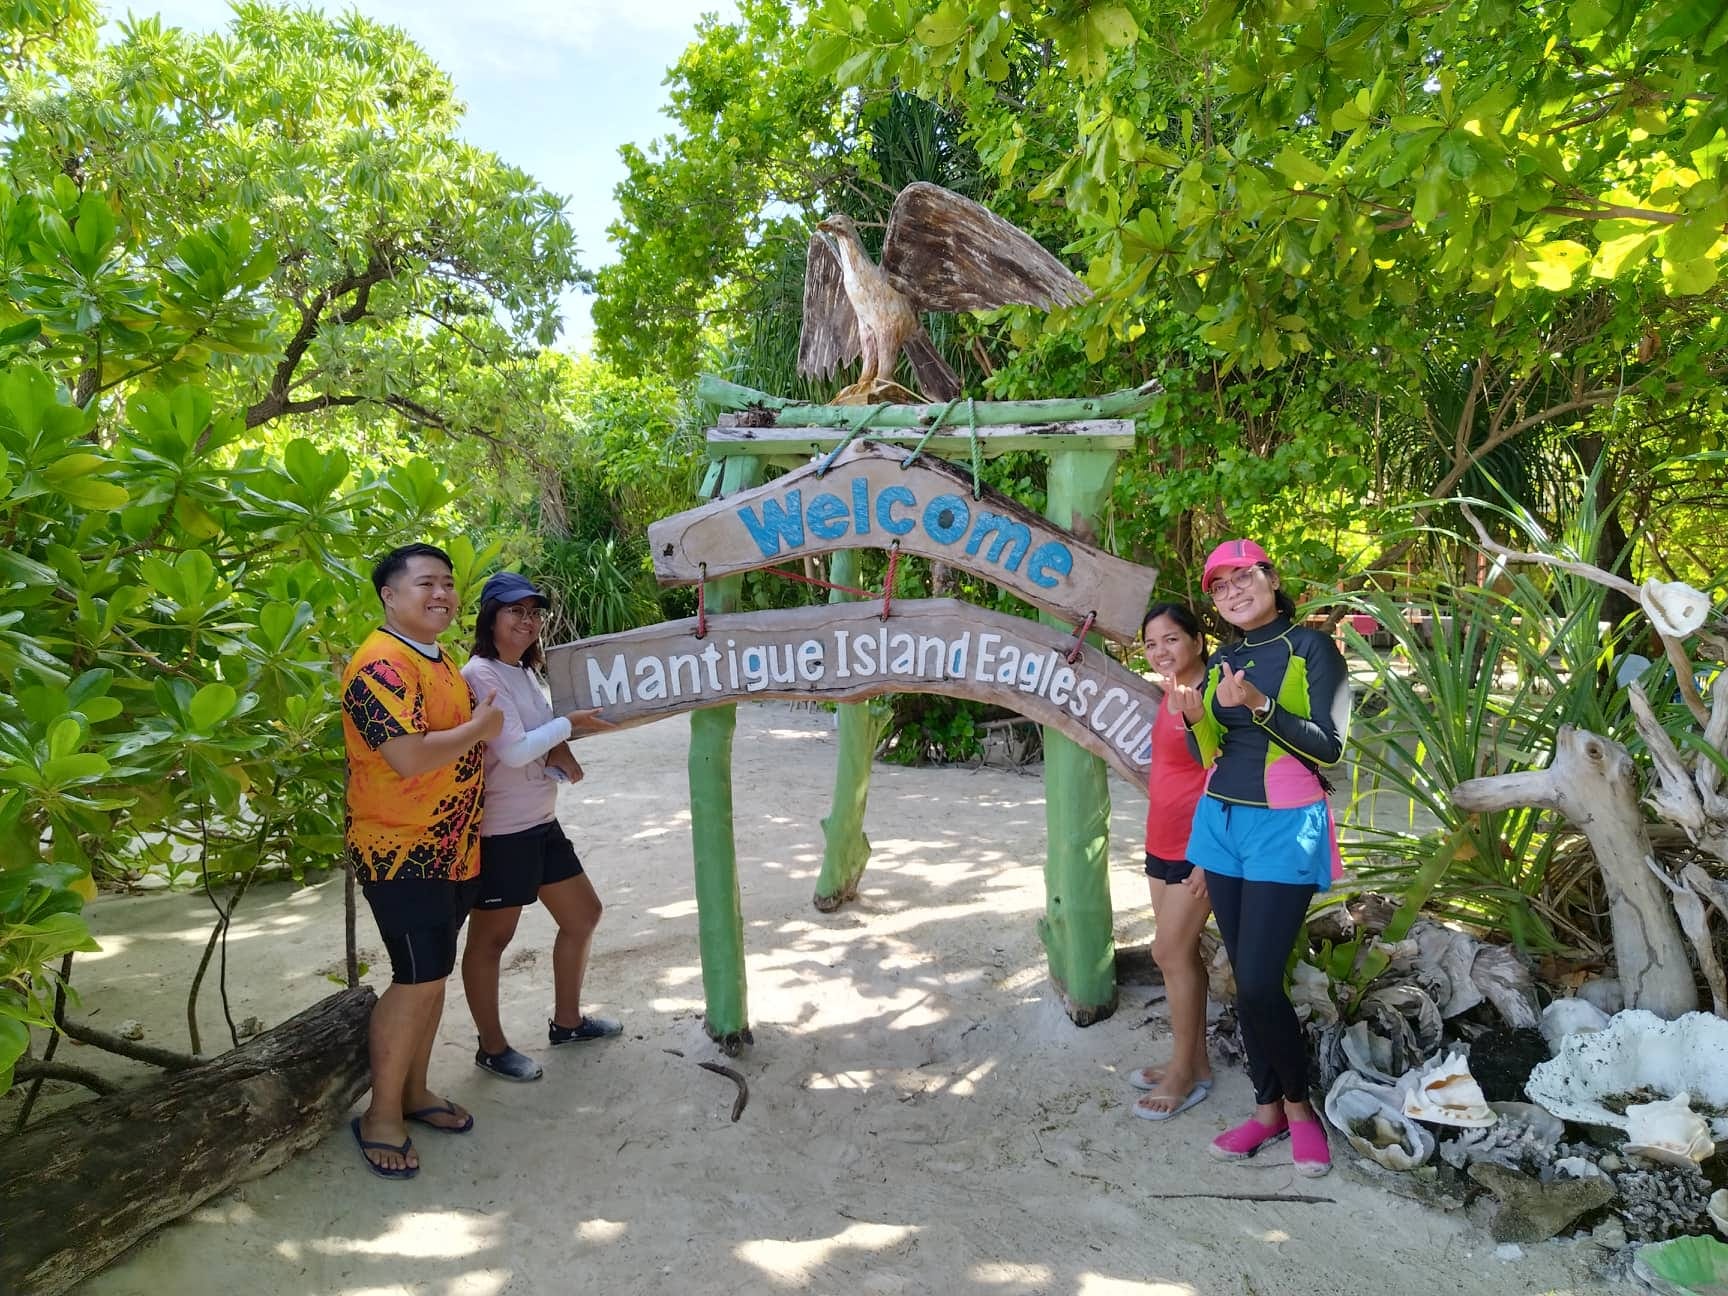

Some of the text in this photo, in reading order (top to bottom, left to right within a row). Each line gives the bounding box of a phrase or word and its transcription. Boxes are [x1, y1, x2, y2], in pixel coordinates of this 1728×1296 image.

[737, 477, 1074, 588] Welcome
[586, 639, 825, 707] Mantigue
[834, 627, 971, 679] Island
[976, 632, 1098, 716] Eagles
